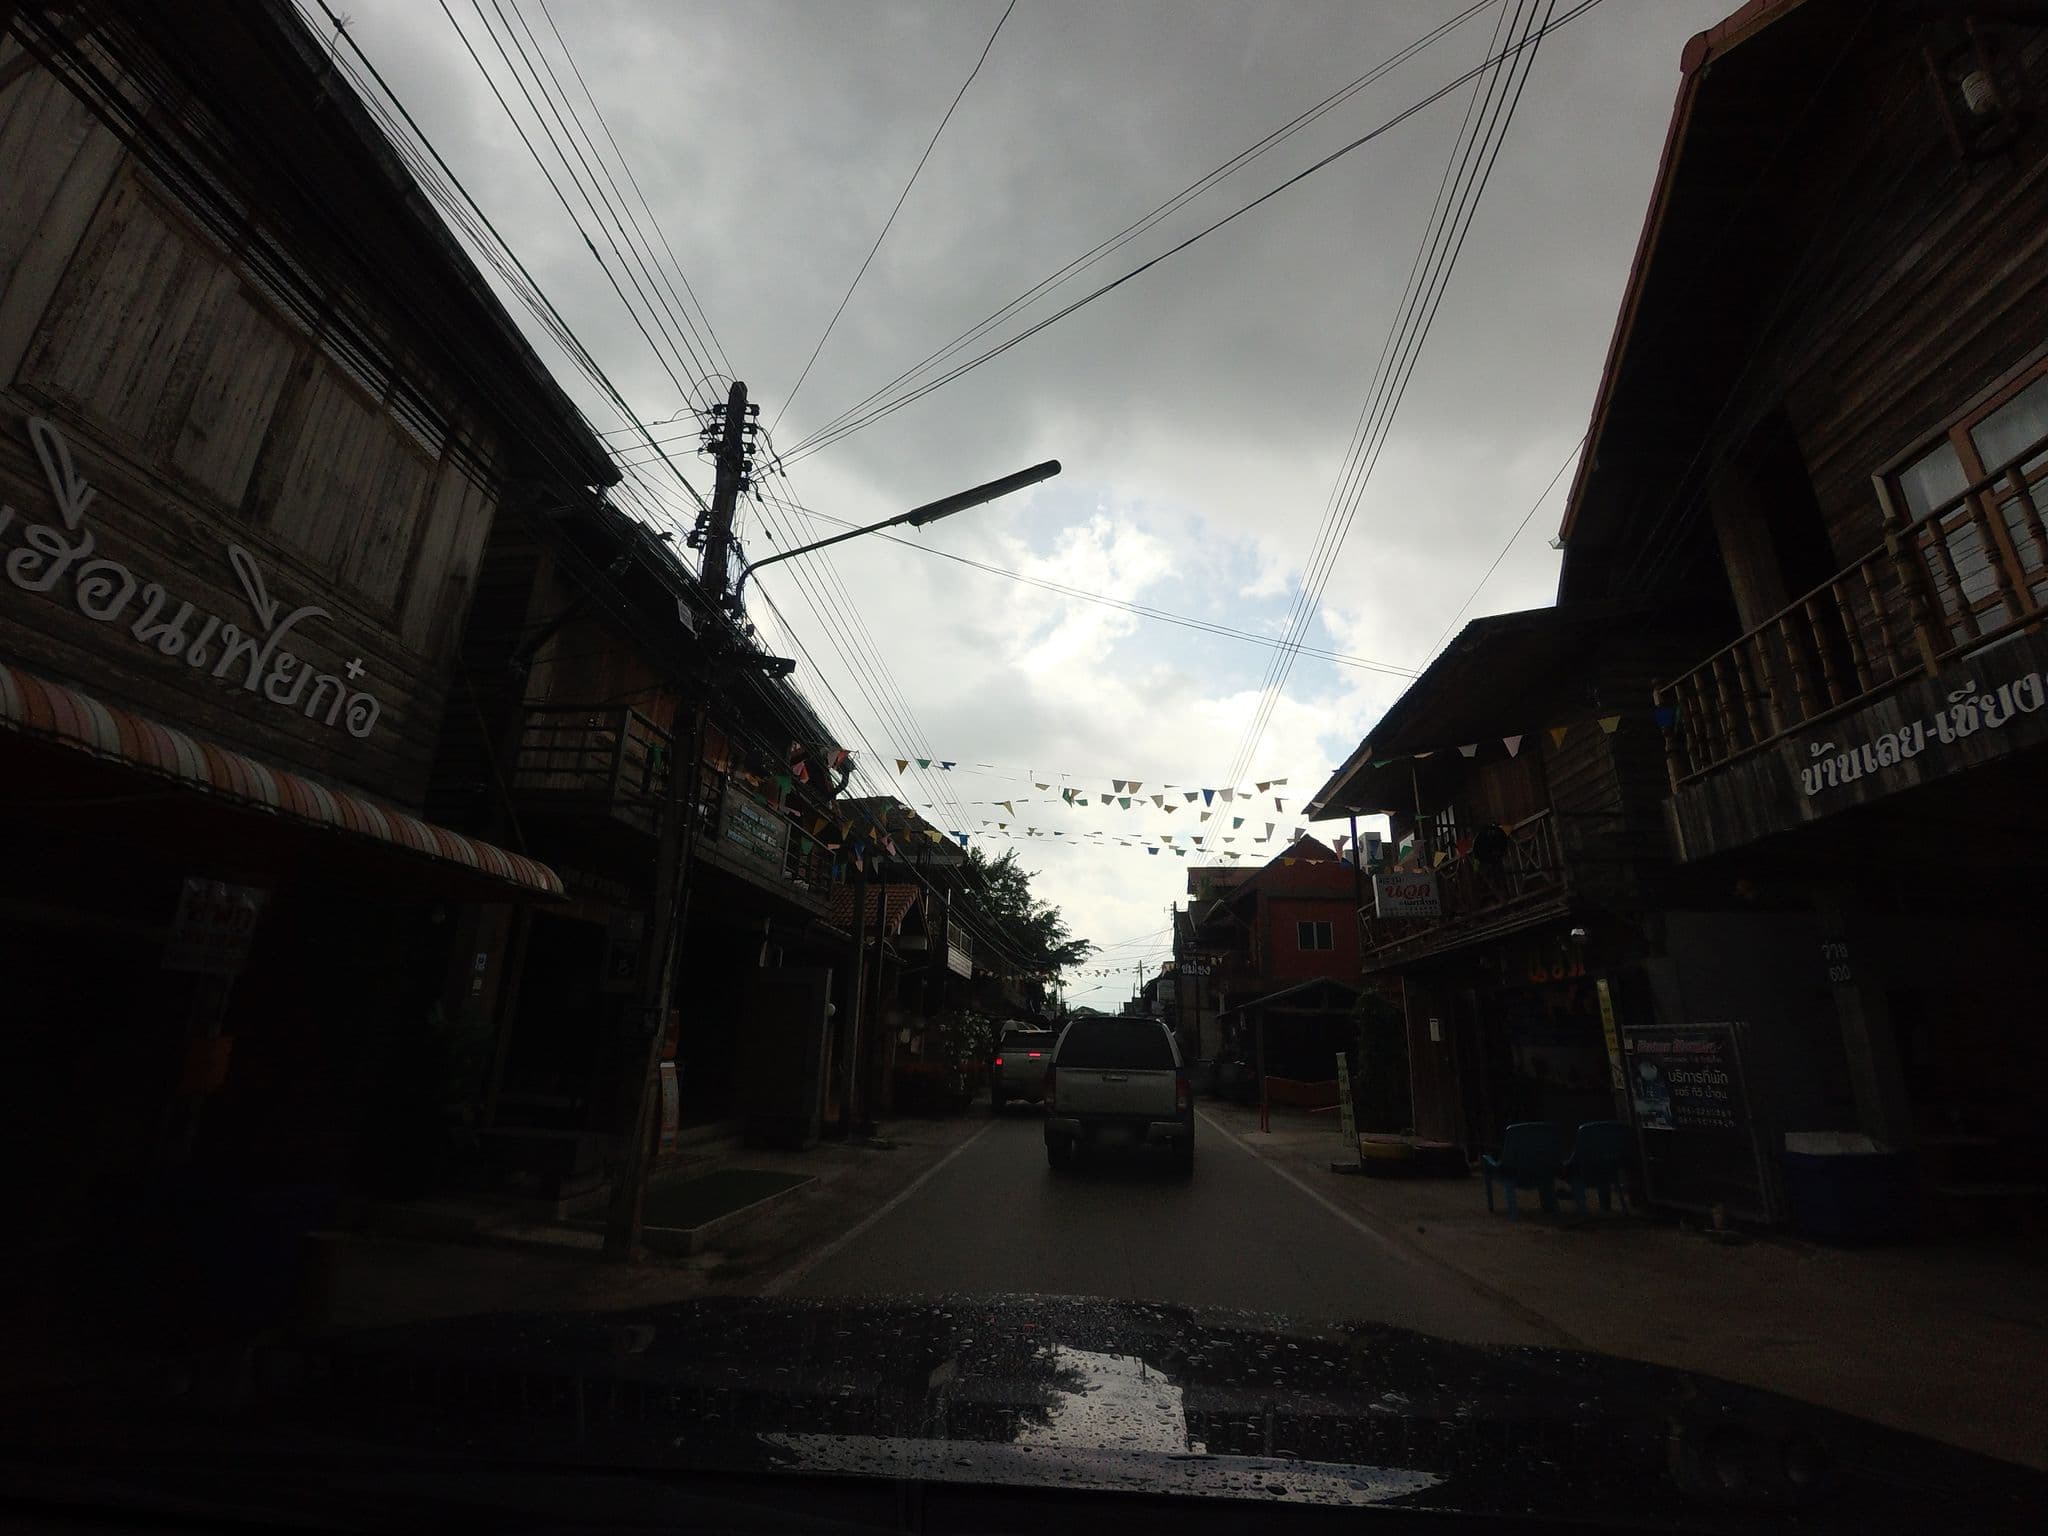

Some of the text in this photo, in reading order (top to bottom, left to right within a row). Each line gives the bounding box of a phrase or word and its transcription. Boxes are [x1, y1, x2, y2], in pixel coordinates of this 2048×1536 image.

[1801, 672, 2048, 796] บ้านเลย-เชียง
[1668, 1066, 1729, 1085] บริการที่พัก
